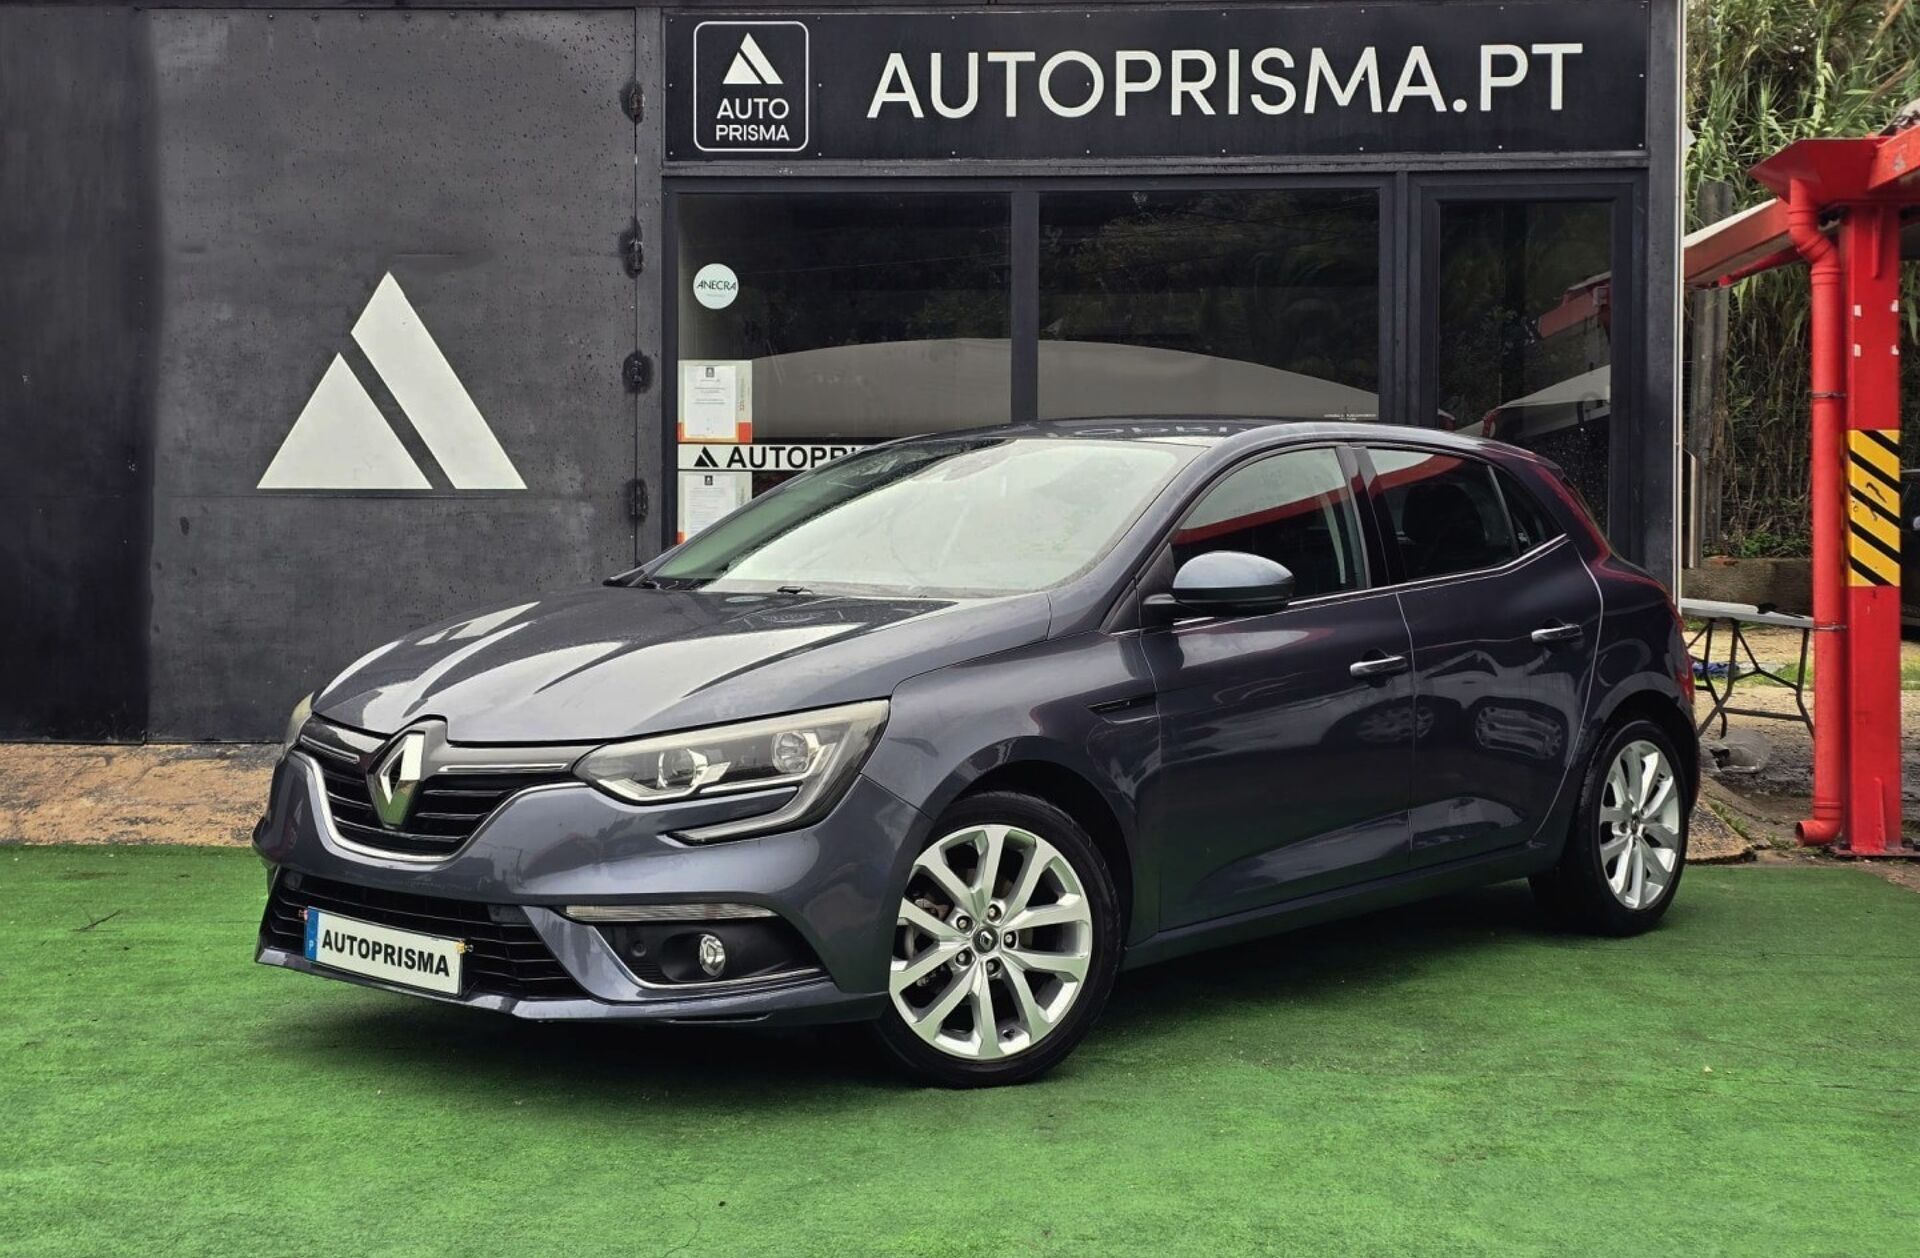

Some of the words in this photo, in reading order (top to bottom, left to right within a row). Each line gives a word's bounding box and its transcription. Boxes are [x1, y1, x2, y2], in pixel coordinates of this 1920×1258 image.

[866, 42, 1584, 119] AUTOPRISMA.PT
[716, 97, 790, 120] AUTO
[715, 124, 790, 142] PRISMA
[696, 280, 737, 291] ANECRA
[321, 928, 451, 978] AUTOPRISMA
